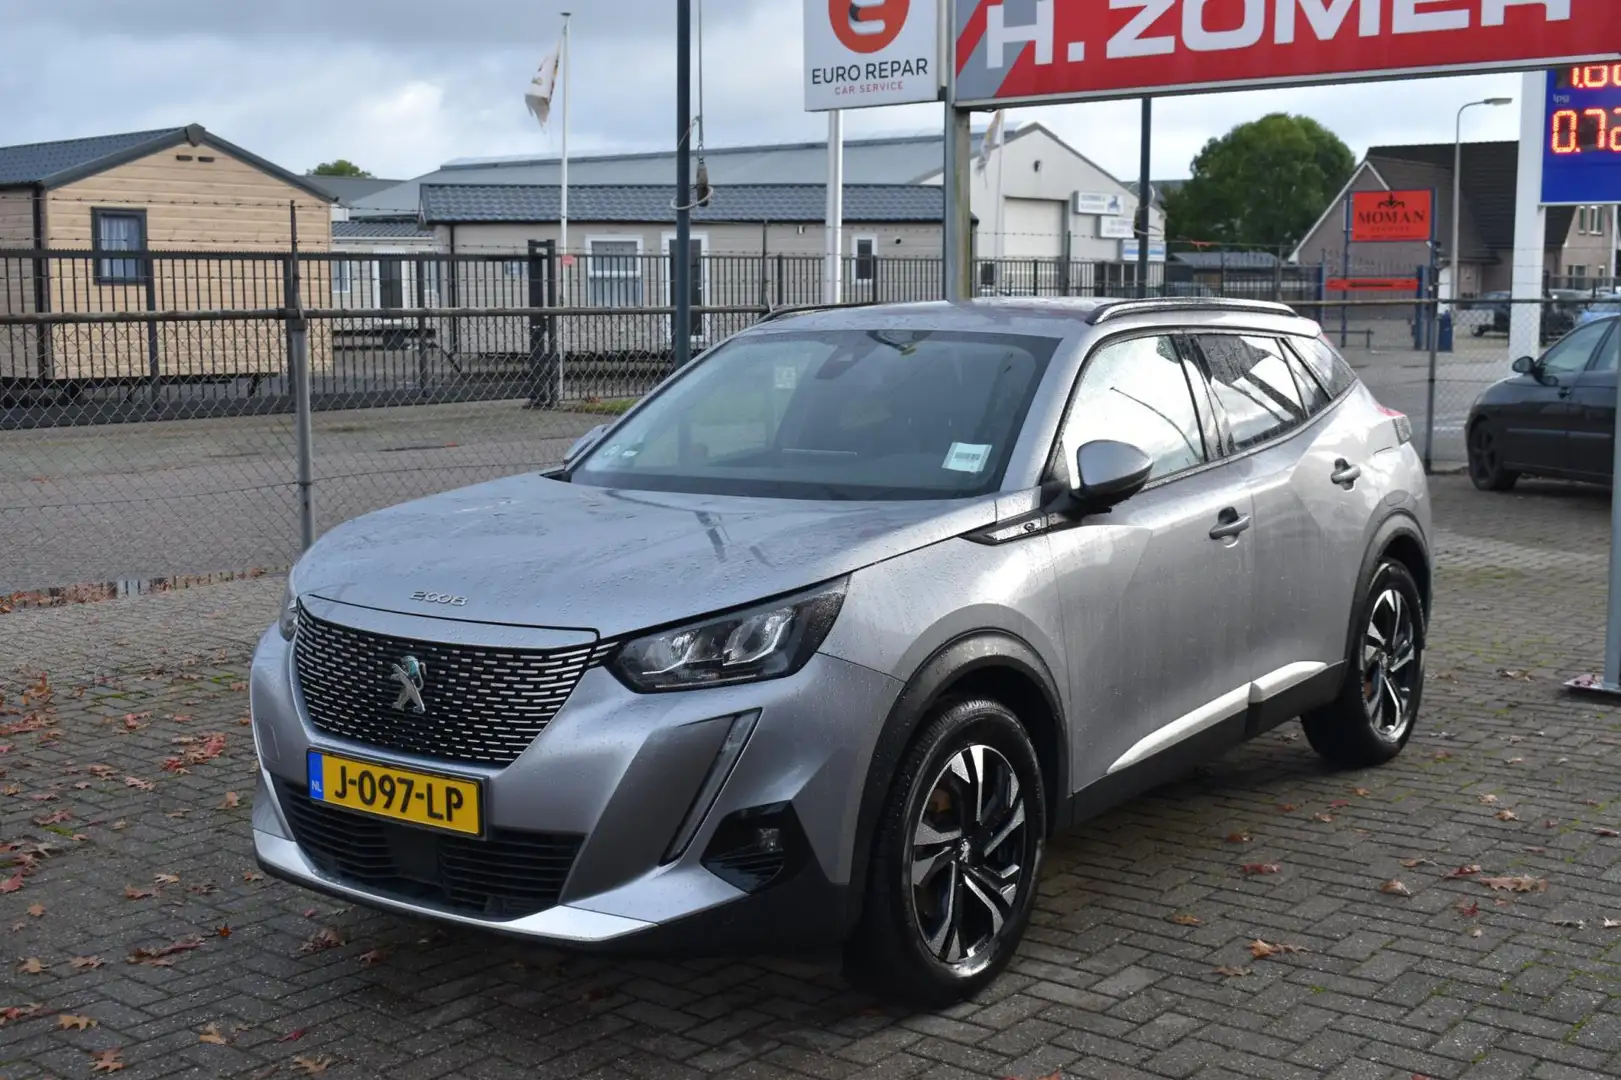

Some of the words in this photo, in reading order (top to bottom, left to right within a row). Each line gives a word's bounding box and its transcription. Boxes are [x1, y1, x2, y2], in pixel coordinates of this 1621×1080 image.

[985, 0, 1086, 69] H.
[811, 64, 861, 85] EURO
[865, 57, 928, 80] REPAR
[834, 85, 855, 95] CAR
[859, 81, 903, 93] SERVICE
[1358, 209, 1426, 225] MOMAN
[409, 591, 468, 606] 2008
[311, 779, 322, 793] NL
[334, 765, 464, 822] J-097-LP
